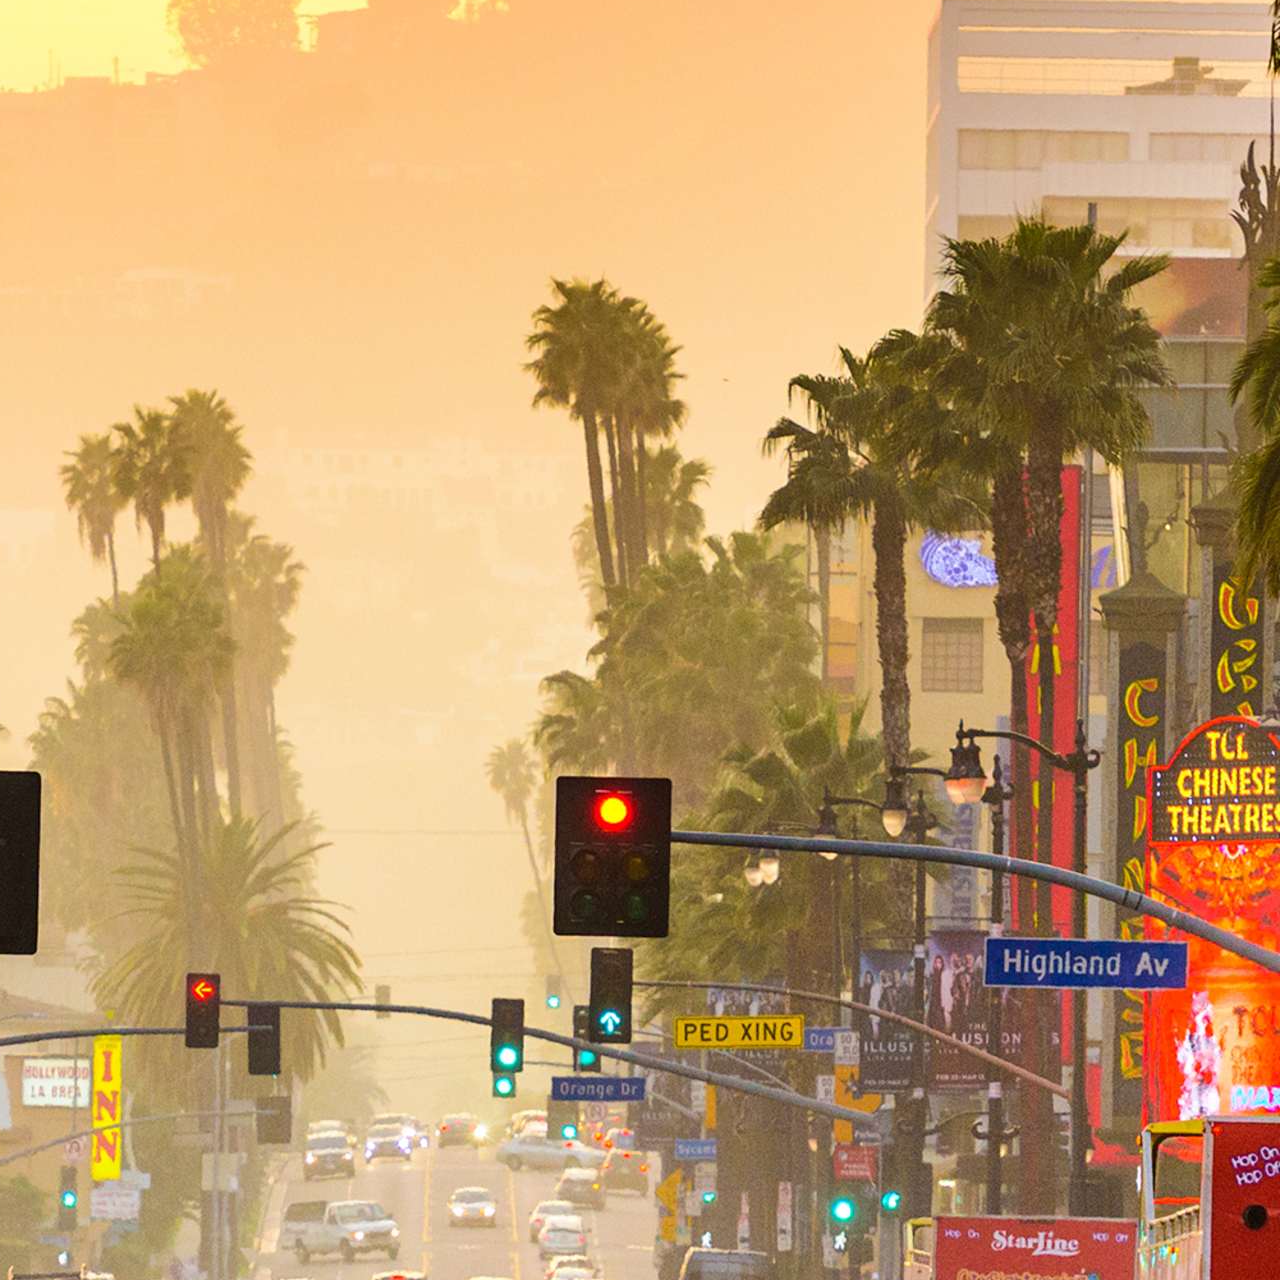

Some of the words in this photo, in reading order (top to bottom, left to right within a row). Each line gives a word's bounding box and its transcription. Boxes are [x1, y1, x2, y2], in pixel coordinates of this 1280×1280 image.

[1205, 730, 1249, 762] TCL
[1176, 768, 1276, 799] CHINESE
[1002, 948, 1121, 981] Highland
[1137, 953, 1170, 977] Av
[683, 1023, 729, 1042] PED
[741, 1022, 794, 1041] XING
[809, 1032, 835, 1047] Ora
[24, 1065, 89, 1079] HOLLYWOOD
[559, 1080, 615, 1103] Orange
[620, 1080, 639, 1097] Dr
[95, 1051, 120, 1164] INN
[1232, 1152, 1258, 1170] Hop
[1260, 1145, 1280, 1161] On
[1236, 1168, 1263, 1186] Hop
[944, 1228, 961, 1239] Hop
